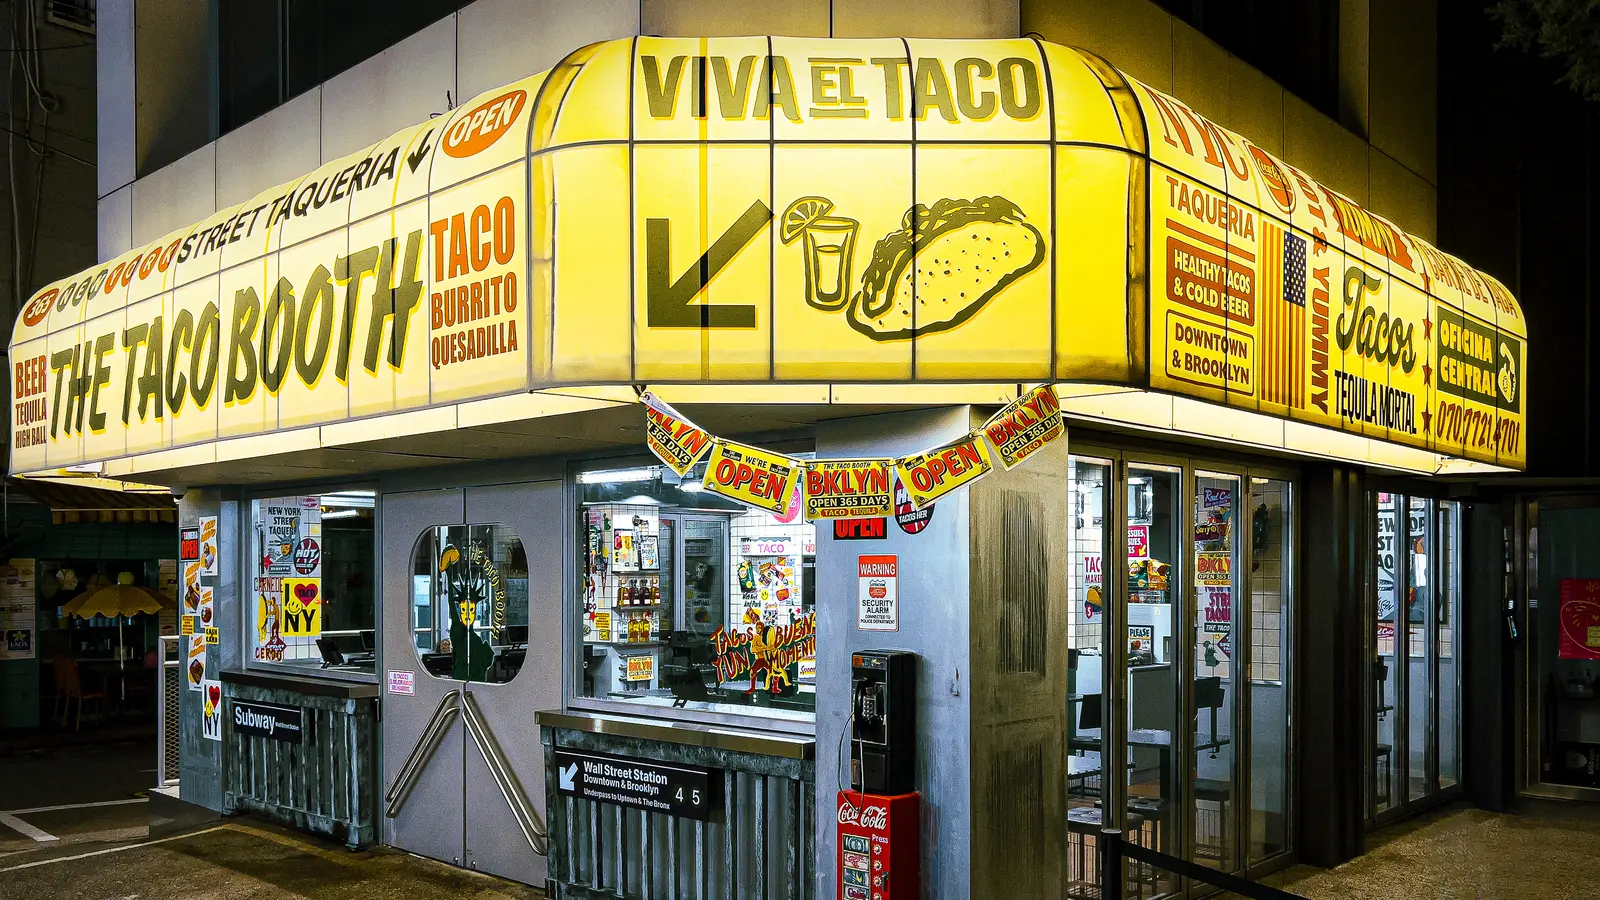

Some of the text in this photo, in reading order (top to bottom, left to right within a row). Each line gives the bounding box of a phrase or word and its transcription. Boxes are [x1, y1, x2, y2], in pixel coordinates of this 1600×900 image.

[641, 55, 1041, 121] VIVA EL TACO
[448, 92, 525, 148] OPEN
[1143, 86, 1249, 181] NYC
[1166, 176, 1255, 242] TAQUERIA
[28, 146, 401, 318] 365 NEW YORK STREET TAQUERIA
[431, 196, 515, 283] TACO
[1174, 249, 1251, 295] HEALTHY TACOS
[431, 272, 517, 330] BURRITO
[1173, 277, 1250, 319] & COLD BEER
[50, 229, 424, 440] THE TACO BOOTH
[1336, 266, 1417, 374] Tacos
[431, 320, 518, 370] QUESADILLA
[1175, 322, 1247, 359] DOWNTOWN
[1311, 267, 1330, 415] YUMMY
[1440, 319, 1493, 364] OFICINA
[16, 355, 47, 399] BEER
[1172, 350, 1250, 385] & BROOKLYN
[1440, 354, 1497, 398] CENTRAL
[16, 397, 47, 426] TEQUILA
[986, 386, 1059, 447] BKLYN
[1334, 370, 1417, 434] TEQUILA MORTAL
[16, 426, 47, 448] HIGH BALL
[651, 426, 691, 464] 365 DAYS
[1002, 435, 1027, 456] OPEN
[1027, 426, 1044, 439] 365
[1021, 442, 1040, 456] TACO
[745, 455, 768, 468] WE'RE
[911, 442, 983, 492] OPEN
[716, 458, 787, 502] OPEN
[806, 467, 889, 497] BKLYN
[267, 507, 302, 516] NEW YORK
[809, 498, 837, 508] OPEN
[840, 497, 858, 506] 365
[860, 495, 888, 505] DAYS
[835, 517, 883, 538] OPEN
[899, 511, 916, 523] TACOS
[296, 549, 317, 558] HOT
[758, 544, 784, 553] TACO
[860, 563, 896, 575] WARNING
[1085, 557, 1102, 573] TAC
[285, 583, 290, 606] I
[298, 588, 316, 597] TACO
[862, 599, 893, 607] SECURITY
[285, 609, 316, 632] NY
[1129, 628, 1150, 637] PLEASE
[709, 624, 754, 655] TACOS
[204, 713, 220, 736] NY
[235, 706, 275, 734] Subway
[583, 761, 668, 785] Wall Street Station
[584, 774, 659, 796] Downtown & Brooklyn
[584, 788, 611, 800] Underpass
[611, 792, 617, 801] to
[617, 793, 638, 804] Uptown
[642, 797, 653, 807] The
[653, 800, 670, 810] Bronx
[675, 787, 700, 805] 4 5
[872, 834, 888, 844] Press
